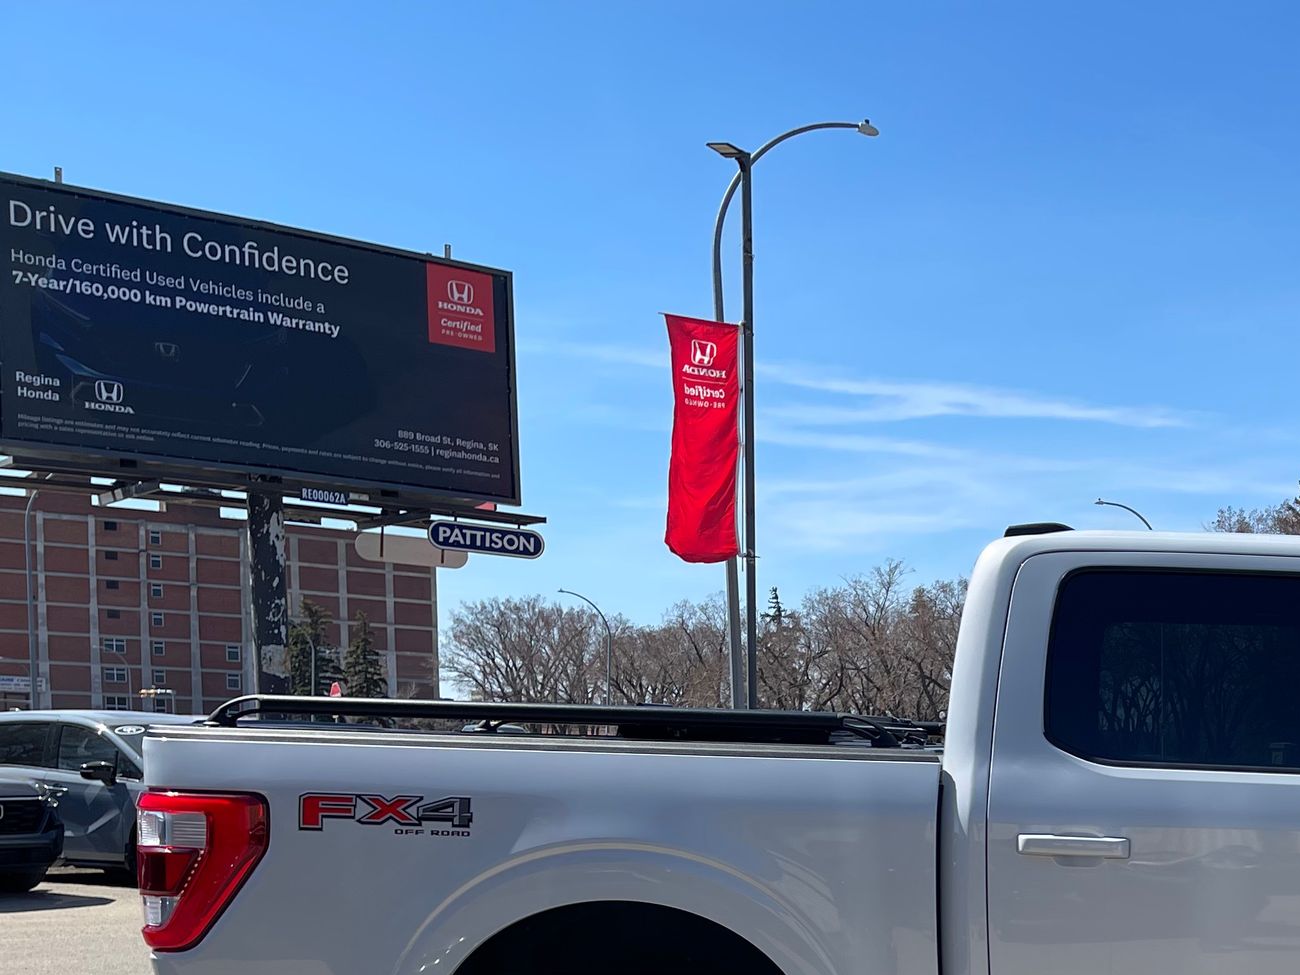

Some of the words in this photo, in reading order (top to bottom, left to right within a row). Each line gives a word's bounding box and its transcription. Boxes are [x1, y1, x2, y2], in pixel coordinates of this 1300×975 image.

[9, 200, 94, 238] Drive
[105, 220, 171, 252] with
[183, 233, 349, 284] Confidence
[11, 248, 66, 270] Honda
[71, 259, 140, 282] Certified
[146, 271, 184, 289] Used
[190, 278, 253, 301] Vehicles
[258, 289, 312, 311] include
[316, 302, 325, 314] a
[12, 270, 140, 302] 7-Year/160,000
[145, 290, 171, 307] km
[175, 296, 264, 323] Powertrain
[268, 311, 340, 338] Warranty
[437, 301, 484, 316] HONDA
[441, 318, 482, 333] Certified
[15, 371, 60, 387] Regina
[17, 386, 59, 401] Honda
[84, 401, 135, 414] HONDA
[398, 430, 414, 440] 889
[416, 432, 440, 444] Broad
[456, 438, 486, 450] Regina,
[488, 442, 499, 451] SK
[374, 439, 430, 454] 306-525-1555
[436, 449, 499, 464] reginahonda.ca
[302, 487, 346, 504] RE00062A
[438, 526, 535, 553] PATTISON
[298, 792, 473, 831] FX4
[394, 828, 425, 836] OFF
[431, 829, 471, 837] ROAD
